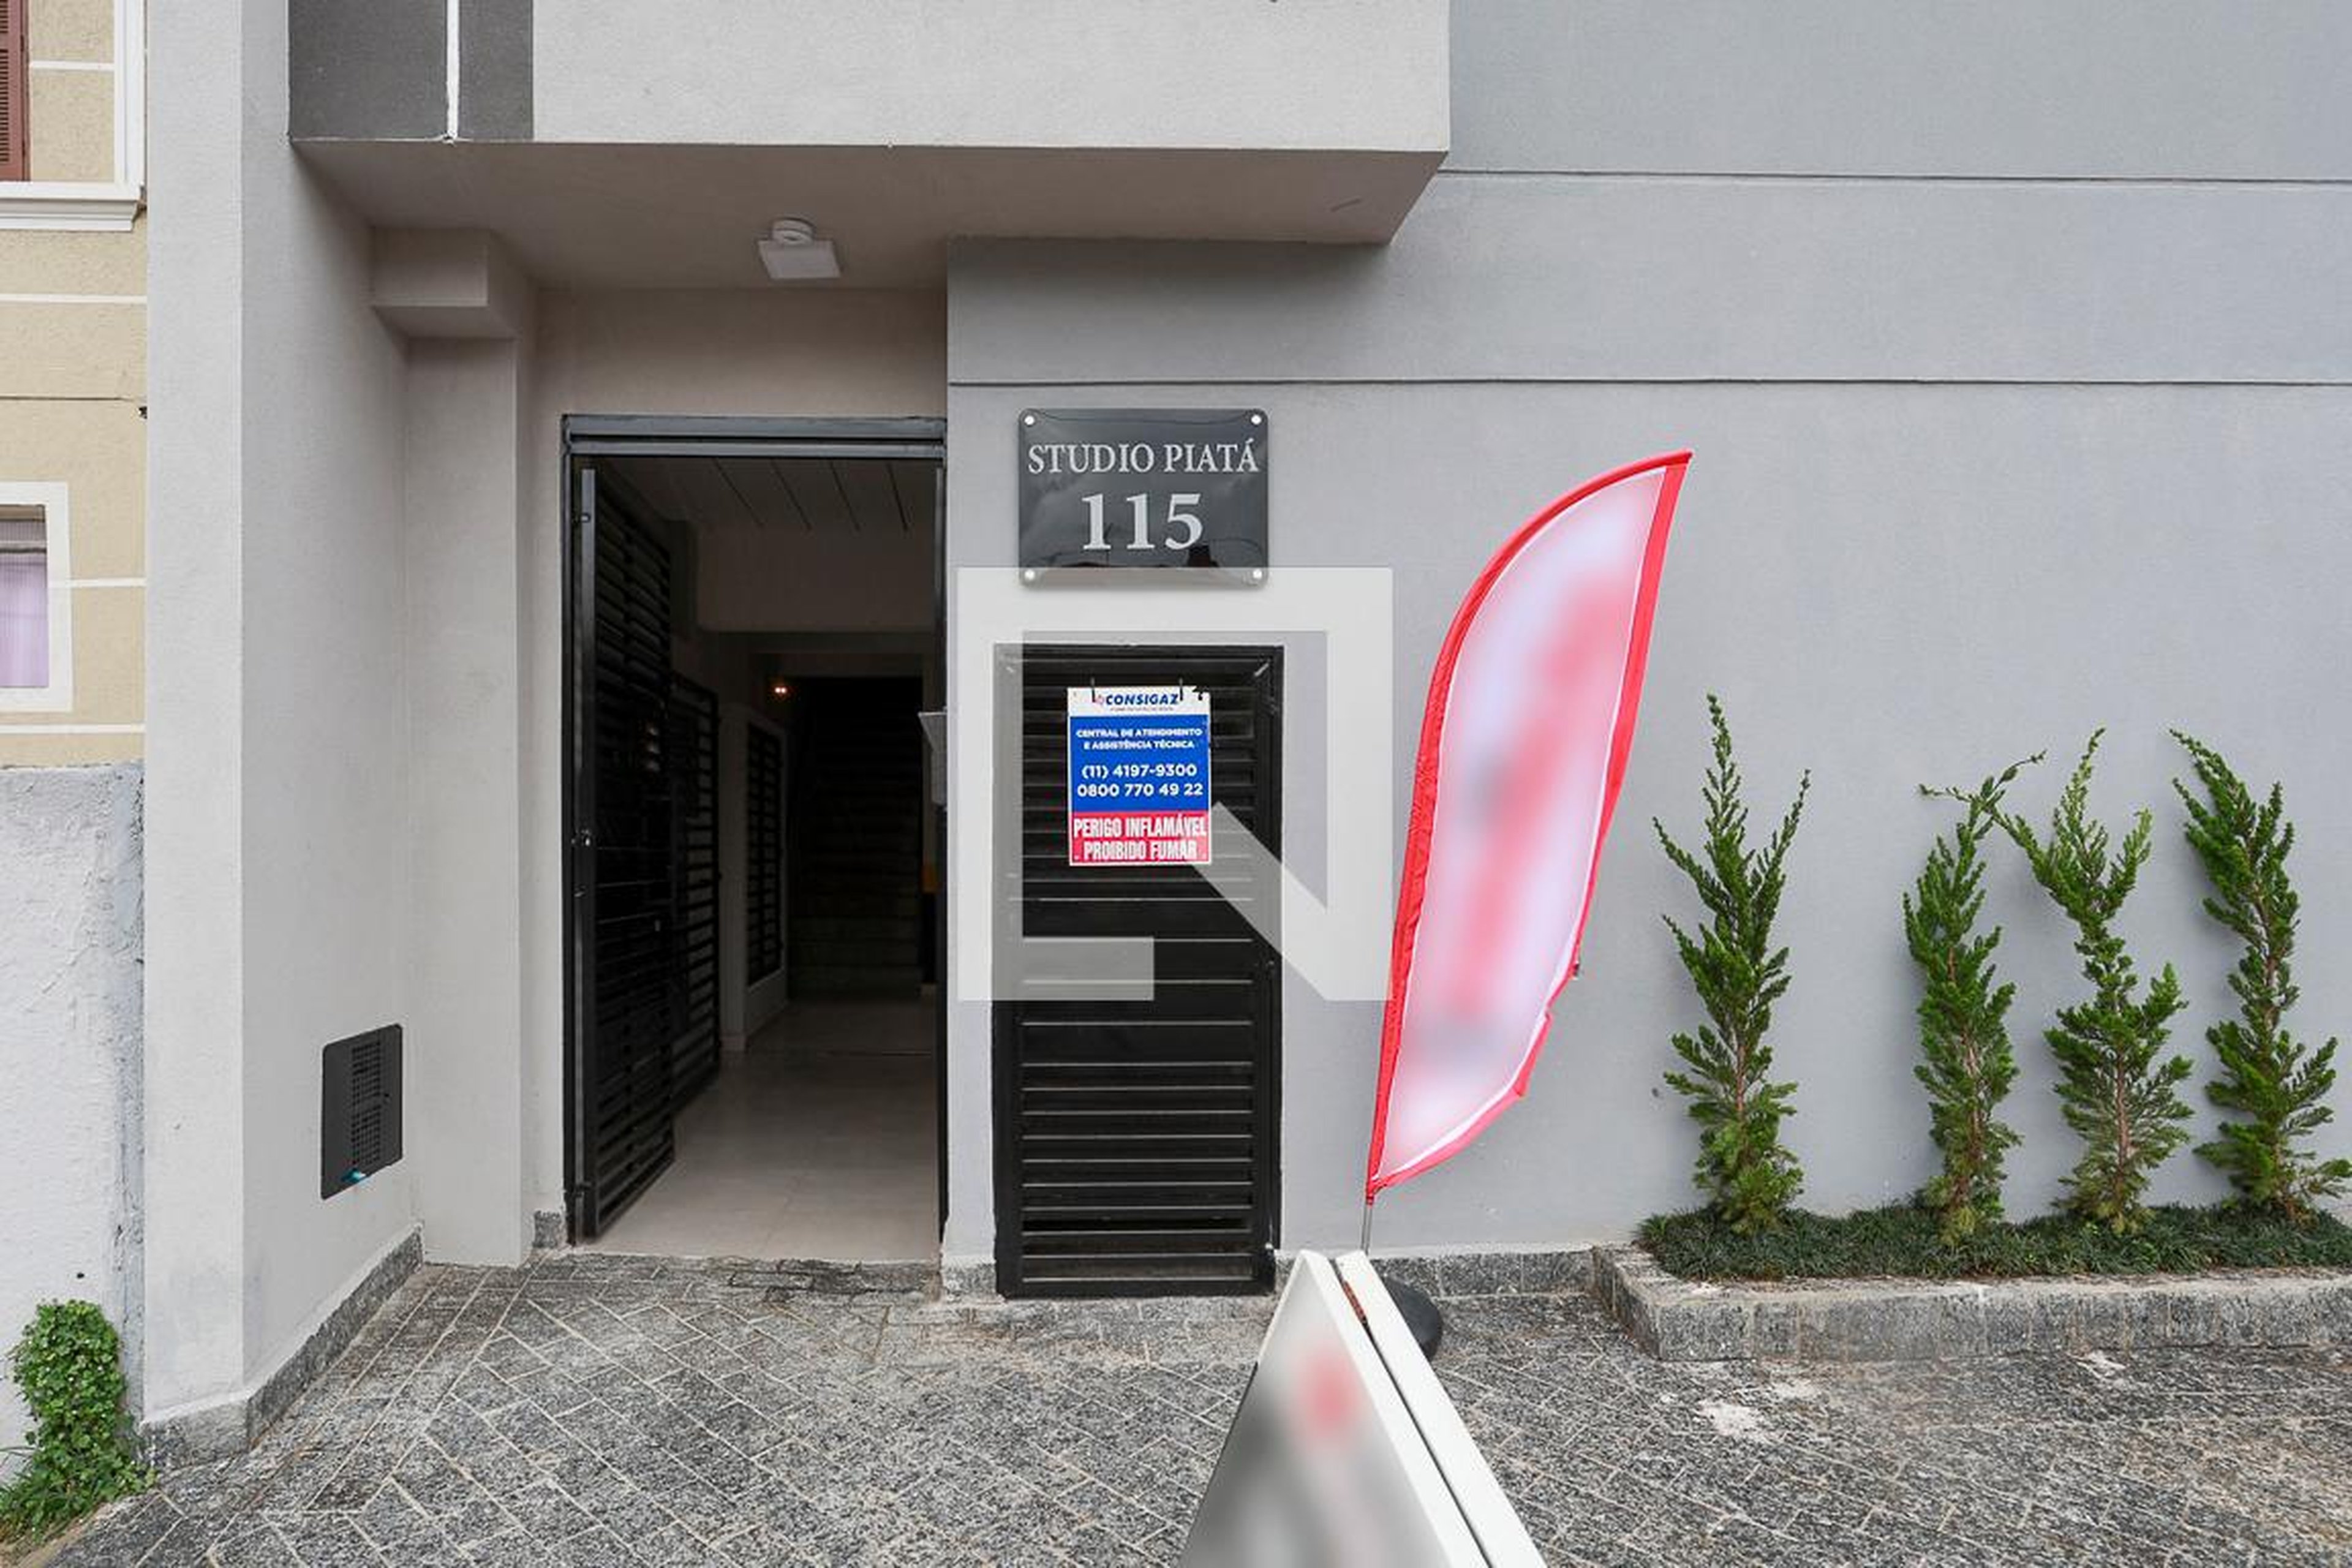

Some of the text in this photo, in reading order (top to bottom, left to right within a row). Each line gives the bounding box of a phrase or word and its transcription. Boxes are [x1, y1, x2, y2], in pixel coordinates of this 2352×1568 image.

[1028, 438, 1260, 473] STUDIO PIATÁ
[1082, 493, 1203, 550] 115
[1106, 693, 1179, 705] CONSIGAZ
[1076, 729, 1118, 738] CENTRAL
[1135, 728, 1203, 736] ATENDIMENTO
[1084, 738, 1195, 750] E ASSISTÊNCIA TÉCNICA
[1082, 764, 1198, 779] (11) 4197-9300
[1077, 783, 1204, 797] 0800 770 49 22
[1074, 814, 1207, 838] PERIGO INFLAMÁVEL
[1084, 840, 1197, 860] PROIBIDO FUMAR
